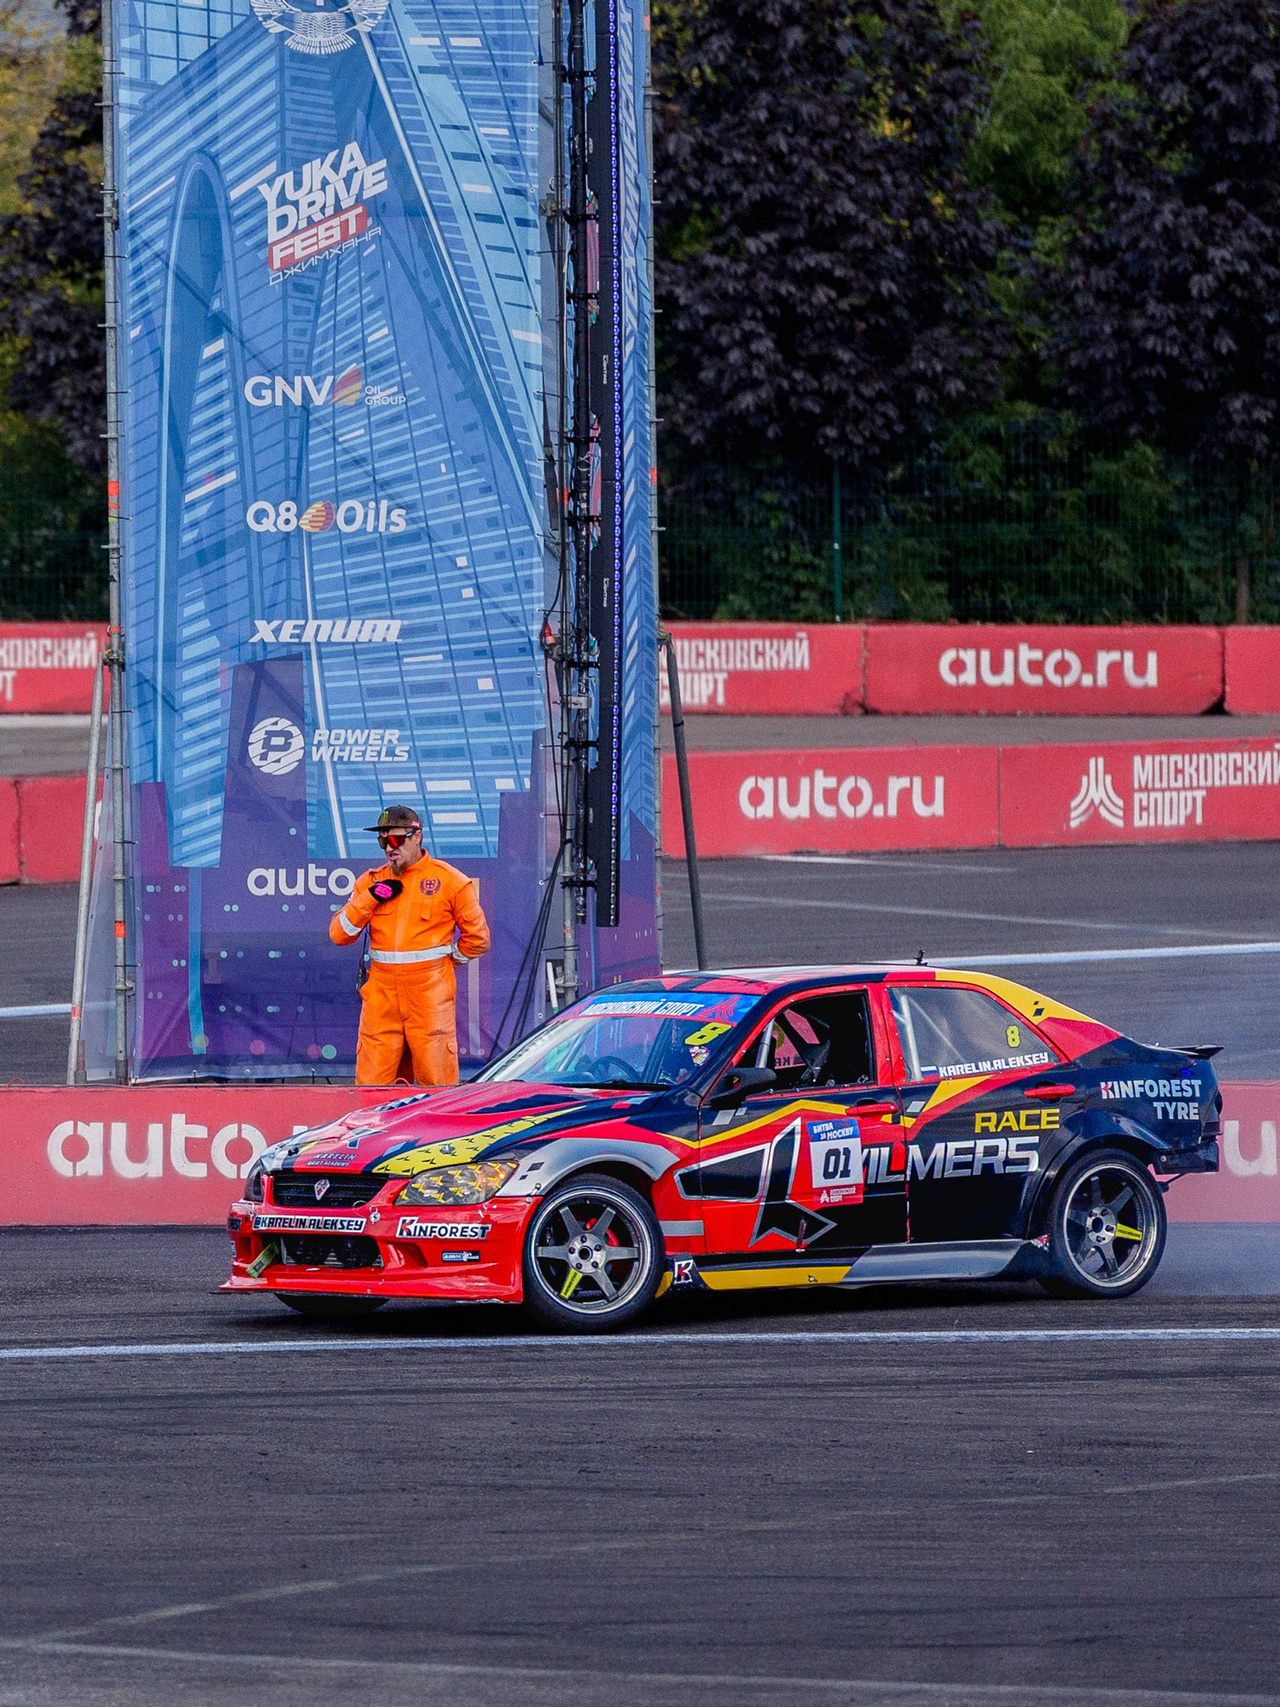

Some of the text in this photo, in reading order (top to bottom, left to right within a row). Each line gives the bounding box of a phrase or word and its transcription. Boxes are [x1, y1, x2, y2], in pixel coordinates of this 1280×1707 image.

[257, 141, 367, 212] YUKA
[268, 158, 388, 244] DRIVE
[272, 206, 364, 271] FEST
[244, 375, 334, 407] GNV
[365, 386, 381, 395] OIL
[365, 396, 407, 406] GROUP
[246, 500, 407, 533] Q8 Oils
[249, 619, 402, 643] XENUM
[938, 642, 1158, 688] auto.ru
[313, 729, 400, 745] POWER
[311, 746, 410, 762] WHEELS
[738, 769, 945, 820] auto.ru
[1133, 789, 1206, 828] СПОРТ
[246, 863, 356, 897] auto
[684, 1022, 732, 1046] 8
[1006, 1025, 1021, 1048] 8
[939, 1052, 1049, 1078] KARELIN.ALEKSEY
[1100, 1079, 1202, 1100] KINFOREST
[975, 1108, 1060, 1132] RACE
[1153, 1102, 1200, 1120] TYRE
[822, 1146, 851, 1180] 01
[399, 1218, 490, 1239] KINFOREST
